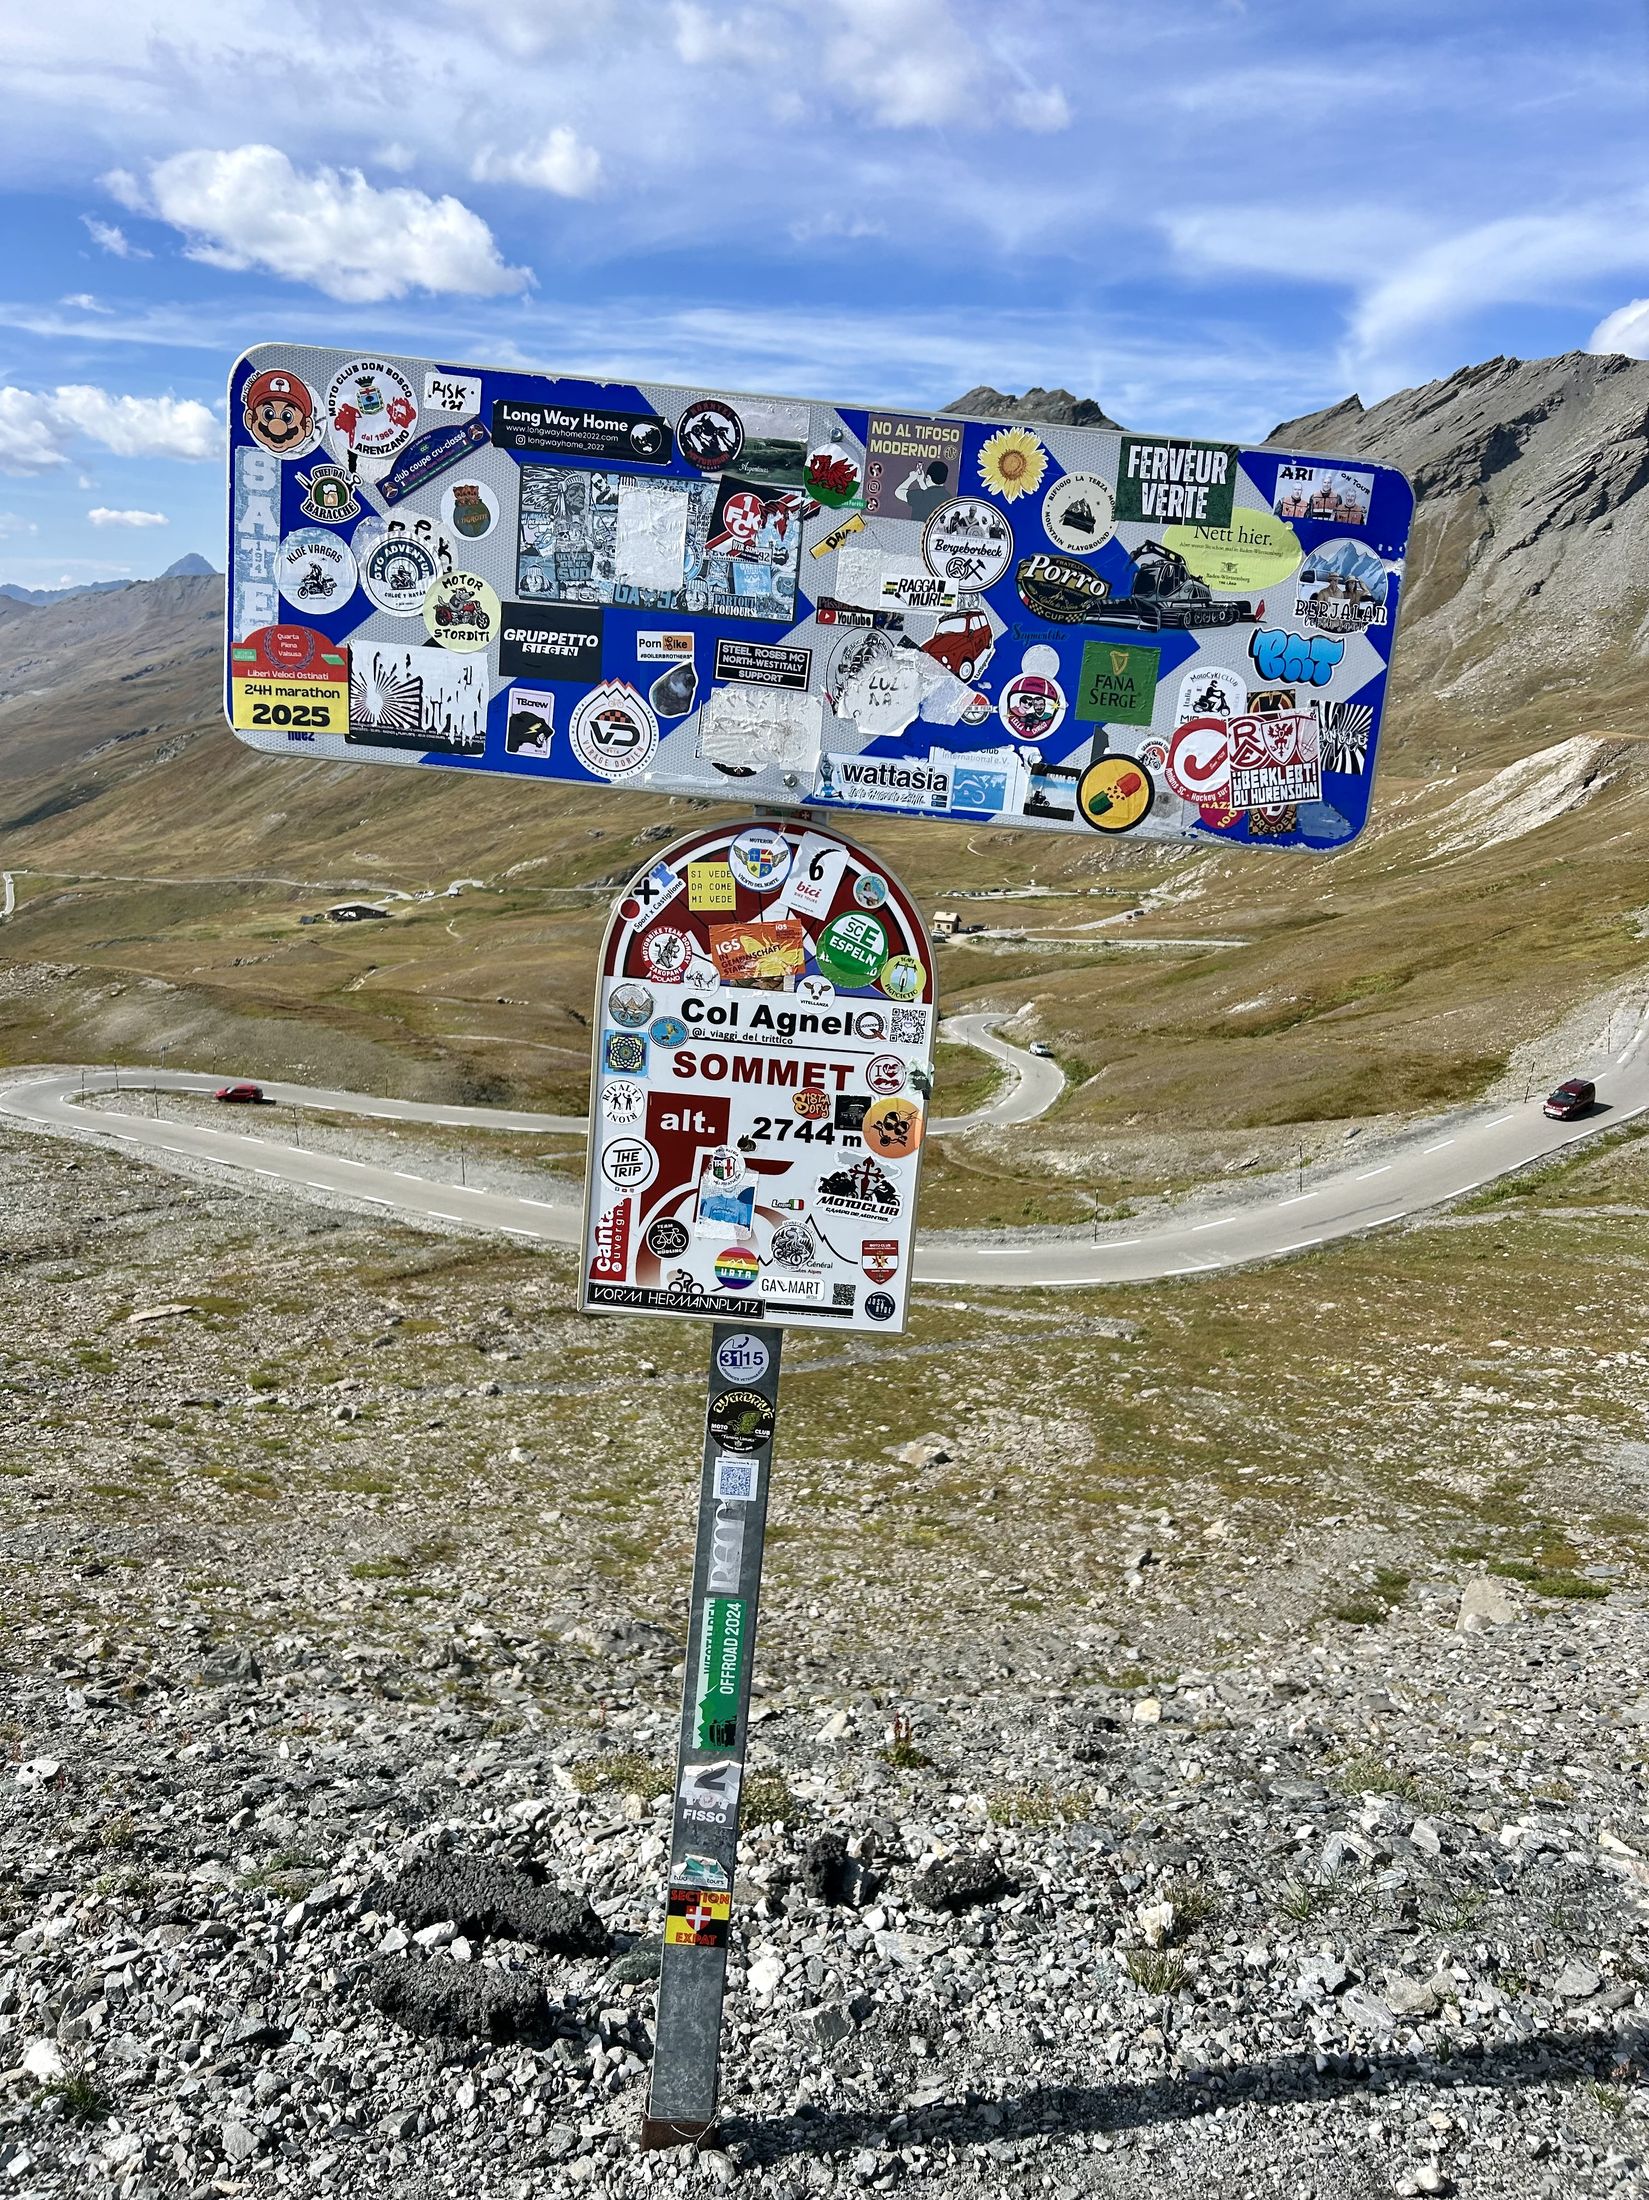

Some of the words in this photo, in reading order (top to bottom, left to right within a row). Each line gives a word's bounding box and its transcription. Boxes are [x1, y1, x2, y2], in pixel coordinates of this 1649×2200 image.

[329, 386, 339, 417] MOTO
[336, 365, 360, 385] CLUB
[361, 362, 384, 372] DON
[386, 367, 413, 399] BOSCO
[502, 405, 542, 427] Long
[543, 409, 580, 430] Way
[583, 413, 629, 433] Home
[505, 425, 619, 443] www.longwayhome2022.com
[872, 421, 893, 436] NO
[895, 424, 912, 438] AL
[915, 426, 961, 443] TIFOSO
[354, 429, 410, 456] ARENZANO
[528, 436, 605, 451] longwayhome_2022
[870, 439, 941, 459] MODERNO!
[394, 469, 410, 483] club
[409, 456, 432, 473] coupe
[432, 430, 467, 457] cru-classé
[1127, 445, 1228, 485] FERVEUR
[1279, 466, 1314, 482] ARI
[1049, 478, 1072, 501] RIFUGIO
[1088, 476, 1109, 493] TERZA
[1341, 473, 1353, 483] ON
[1353, 477, 1371, 496] TOUR
[305, 501, 359, 520] BARACCHE
[1142, 482, 1210, 520] VERTE
[1045, 511, 1065, 546] MOUNTAIN
[1067, 531, 1110, 551] PLAYGROUND
[1194, 526, 1233, 542] Nett
[1237, 525, 1273, 546] hier.
[308, 544, 343, 564] VARGAS
[934, 539, 1003, 558] Bergeborbeck
[442, 574, 484, 591] MOTOR
[1023, 555, 1106, 596] Porro
[898, 578, 937, 593] RAGGA
[908, 592, 942, 606] MURI
[838, 613, 871, 626] YouTube
[1044, 612, 1065, 621] CUP
[1295, 599, 1386, 624] BERJALAN
[434, 628, 490, 643] STORDITI
[503, 628, 599, 648] GRUPPETTO
[638, 638, 662, 649] Porn
[522, 643, 579, 657] SIEGEN
[722, 645, 752, 656] STEEL
[755, 648, 787, 660] ROSES
[789, 653, 805, 663] MC
[722, 655, 778, 669] NORTH-WEST
[779, 662, 803, 672] ITALY
[247, 669, 270, 678] Liberi
[272, 670, 295, 679] Veloci
[297, 672, 329, 680] Ostinati
[738, 670, 783, 683] SUPPORT
[1095, 674, 1135, 692] FANA
[1221, 674, 1238, 688] CLUB
[244, 684, 272, 695] 24H
[275, 686, 341, 699] marathon
[1088, 688, 1138, 709] SERGE
[1183, 689, 1192, 708] Italia
[252, 704, 331, 727] 2025
[582, 740, 609, 767] VIRAGE
[1232, 762, 1317, 791] ÜBERKLEBT!
[1177, 787, 1186, 798] SC
[1191, 792, 1217, 802] Hockey
[1217, 786, 1228, 798] sur
[1234, 790, 1249, 806] DU
[1250, 781, 1318, 806] HURENSOHN
[1251, 809, 1296, 832] DRESDEN
[708, 870, 732, 878] VEDE
[691, 883, 702, 891] DA
[709, 883, 732, 891] COME
[796, 881, 822, 899] bici
[633, 913, 650, 930] Sport
[652, 880, 683, 911] Castiglione
[691, 895, 703, 903] MI
[709, 895, 733, 904] VEDE
[641, 928, 664, 962] MOTORBIKE
[664, 926, 683, 939] TEAM
[681, 932, 692, 963] DONKEY
[715, 938, 741, 956] IGS
[829, 936, 877, 967] ESPELN
[719, 953, 729, 961] IN
[649, 965, 684, 977] ZAKOPANE
[651, 972, 681, 983] POLAND
[681, 998, 739, 1027] Col
[749, 1003, 854, 1038] Agnel
[672, 1050, 855, 1091] SOMMET
[602, 1083, 642, 1102] RIVALTA
[660, 1109, 716, 1134] alt.
[751, 1116, 836, 1146] 2744
[842, 1134, 862, 1148] m
[613, 1148, 643, 1163] THE
[611, 1162, 644, 1178] TRIP
[815, 1195, 900, 1217] MOTOCLUB
[825, 1207, 850, 1215] CAMPO
[806, 1260, 833, 1269] Général
[594, 1287, 643, 1303] VOR'M
[648, 1291, 759, 1314] HERMANNPLATZ
[721, 1350, 764, 1367] 3115
[713, 1391, 774, 1420] OVERDRIVE
[711, 1423, 729, 1431] MOTO
[726, 1602, 742, 1636] 2024
[719, 1637, 739, 1695] OFFROAD
[682, 1808, 727, 1824] FISSO
[706, 1877, 725, 1886] tours
[671, 1889, 731, 1905] SECTION
[675, 1932, 717, 1946] EXPAT
